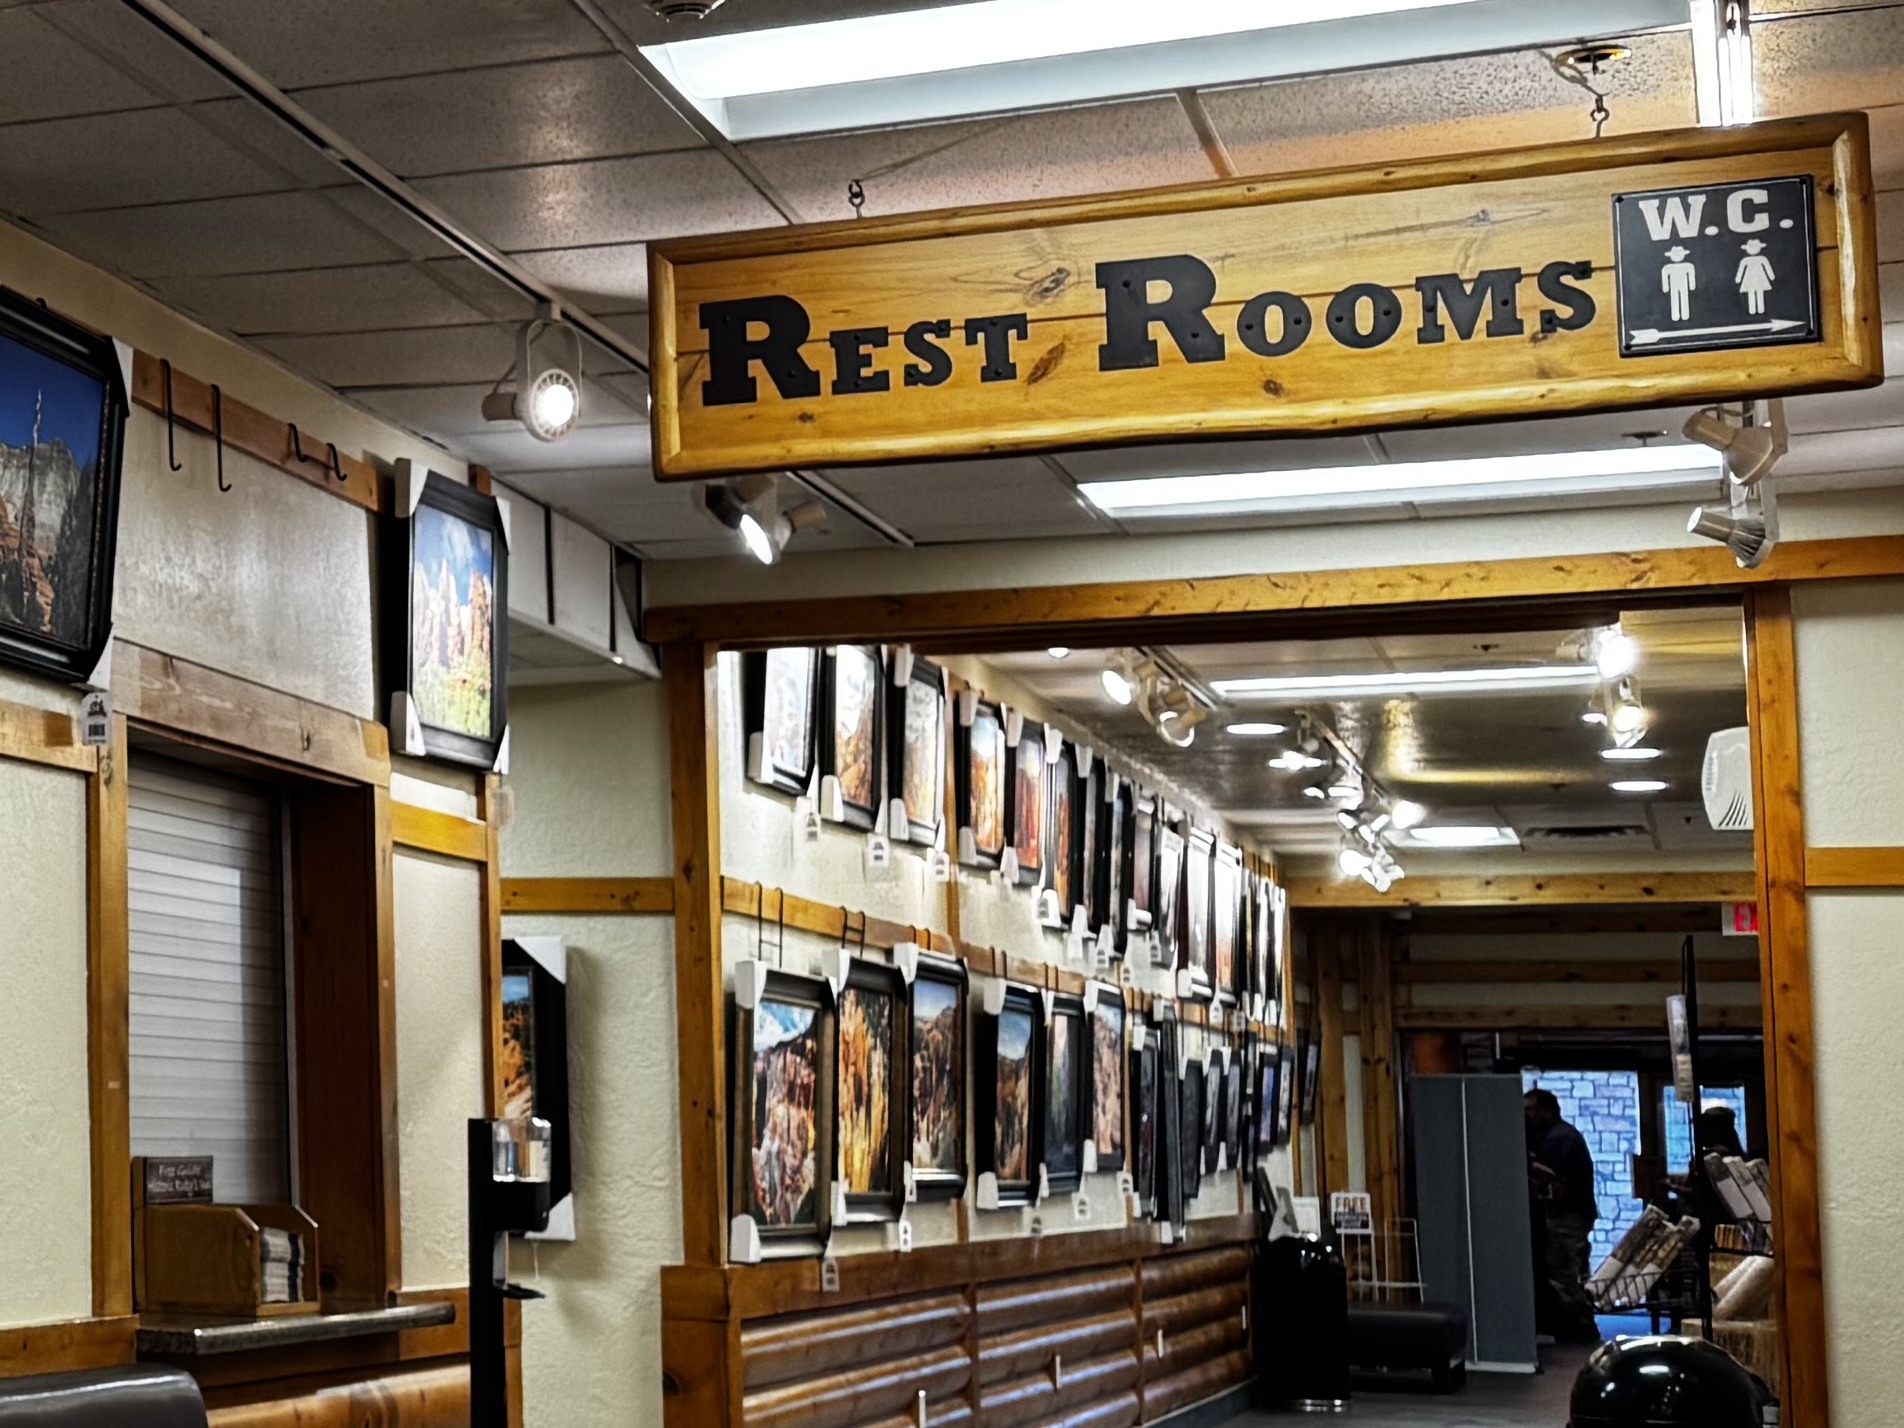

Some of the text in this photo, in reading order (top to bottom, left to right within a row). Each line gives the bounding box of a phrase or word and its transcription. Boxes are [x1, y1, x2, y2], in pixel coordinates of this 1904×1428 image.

[1638, 188, 1794, 241] W.C.
[698, 253, 1597, 408] REST ROOMS
